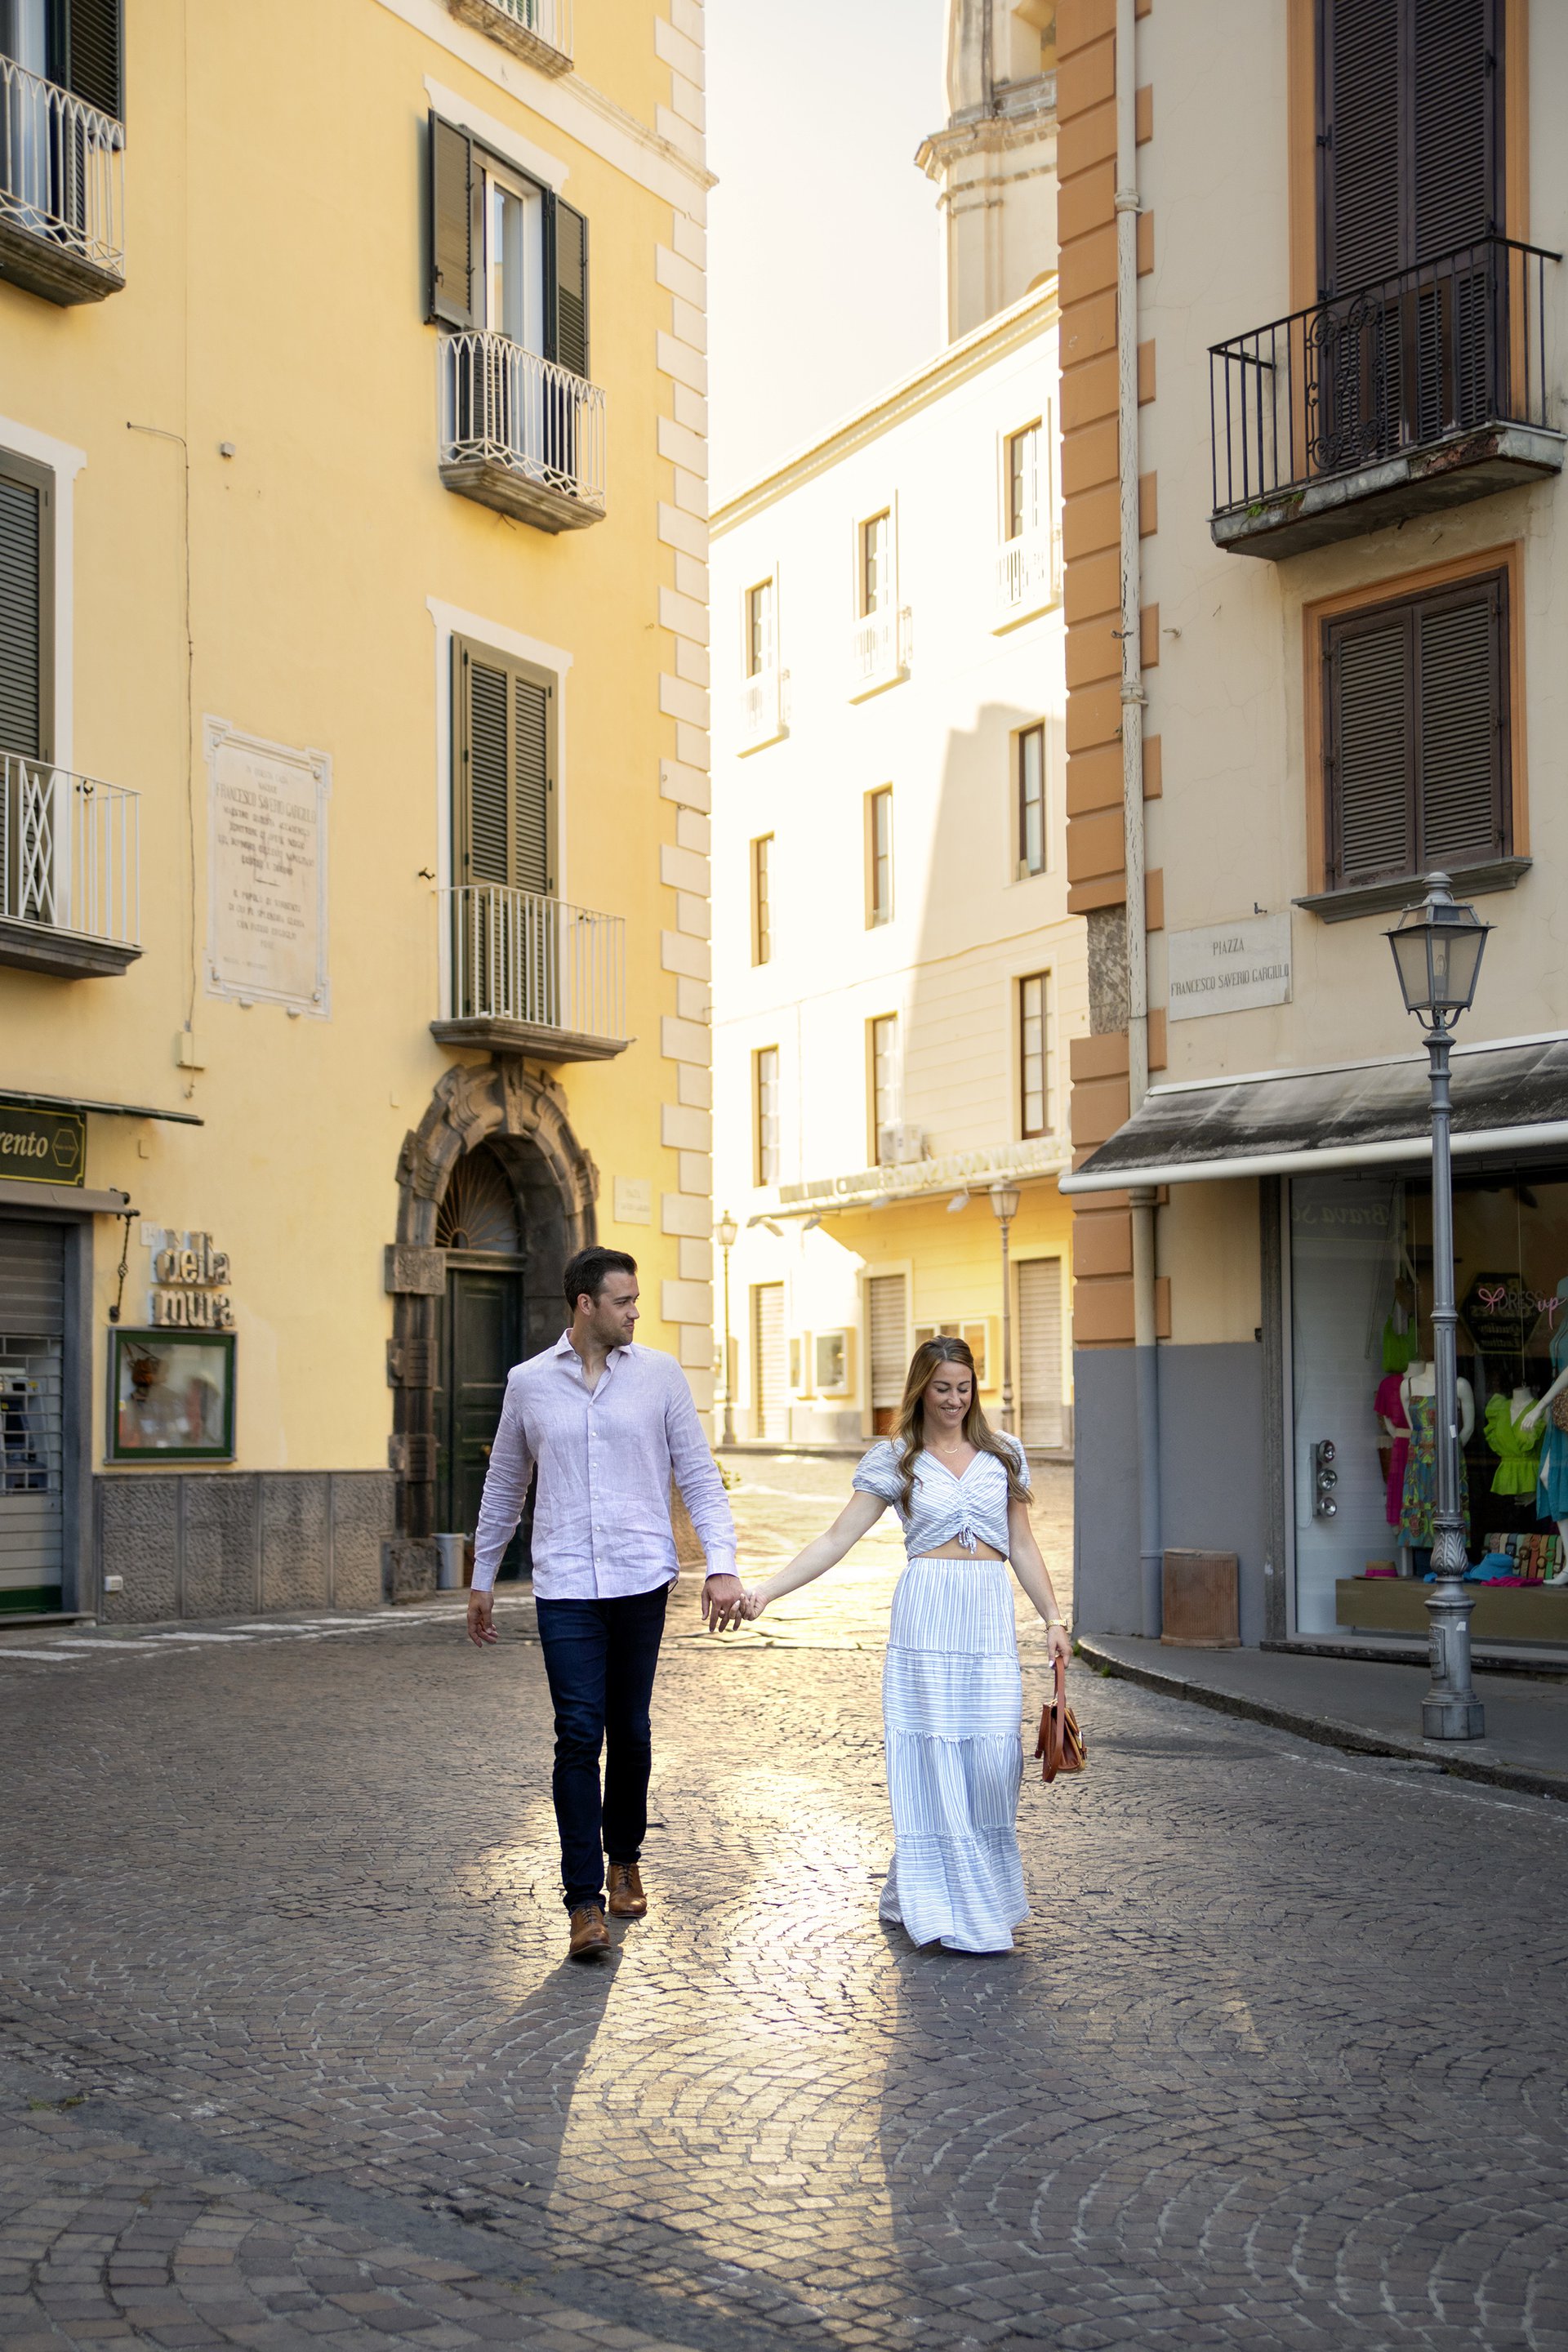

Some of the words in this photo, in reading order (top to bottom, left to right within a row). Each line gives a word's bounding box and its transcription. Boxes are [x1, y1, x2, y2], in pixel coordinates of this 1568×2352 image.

[1213, 938, 1245, 956] PIAZZA
[1171, 976, 1215, 996] FRANCESCO
[1218, 970, 1250, 988] SAVERIO
[1252, 964, 1289, 982] GARGIULO
[147, 1290, 234, 1326] mura
[1498, 1290, 1544, 1310] DRESS
[1538, 1297, 1567, 1330] up
